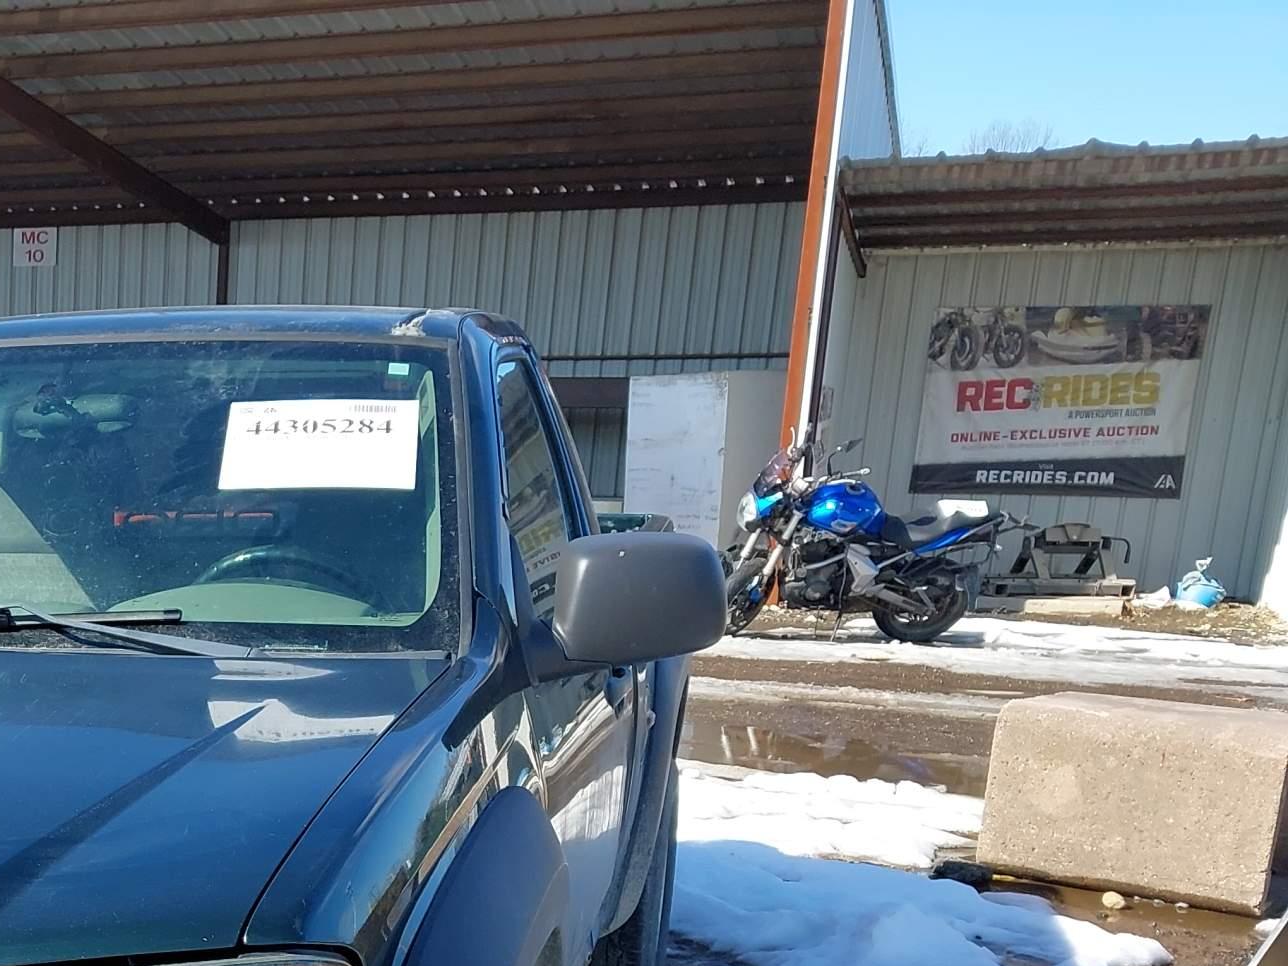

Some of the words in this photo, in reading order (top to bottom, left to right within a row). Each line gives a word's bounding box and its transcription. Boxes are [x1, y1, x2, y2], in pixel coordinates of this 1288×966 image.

[21, 231, 49, 245] MC
[25, 249, 45, 263] 10
[956, 378, 1034, 412] REC
[1042, 372, 1161, 409] RIDES
[1074, 409, 1124, 420] POWERSPORT
[1124, 407, 1157, 418] AUCTION
[246, 418, 393, 436] 44305284
[950, 427, 1092, 443] ONLINE-EXCLUSIVE
[1095, 425, 1161, 438] AUCTION
[975, 470, 1115, 486] RECRIDES.COM
